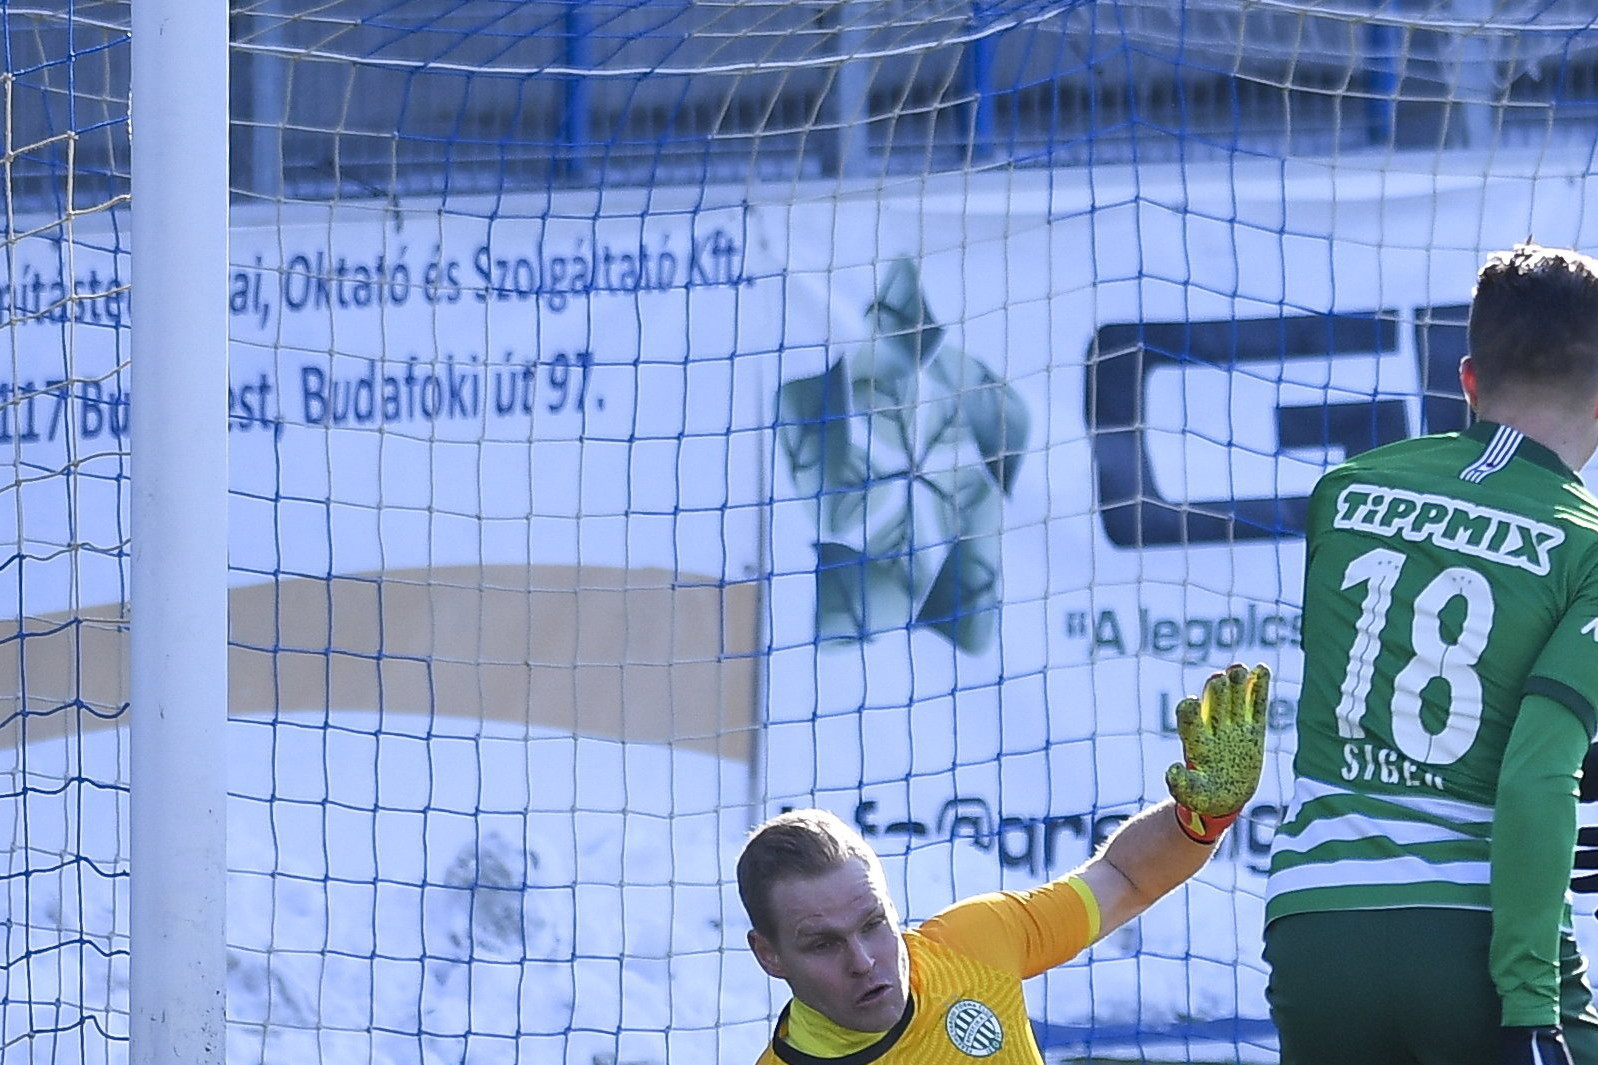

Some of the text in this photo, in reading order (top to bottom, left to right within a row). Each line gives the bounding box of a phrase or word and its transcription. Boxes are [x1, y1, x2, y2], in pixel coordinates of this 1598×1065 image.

[283, 243, 411, 312] Oktató
[424, 242, 462, 303] és
[301, 352, 478, 426] Budafoki
[495, 352, 534, 416] út
[548, 352, 605, 415] 97.
[1339, 547, 1495, 765] 18
